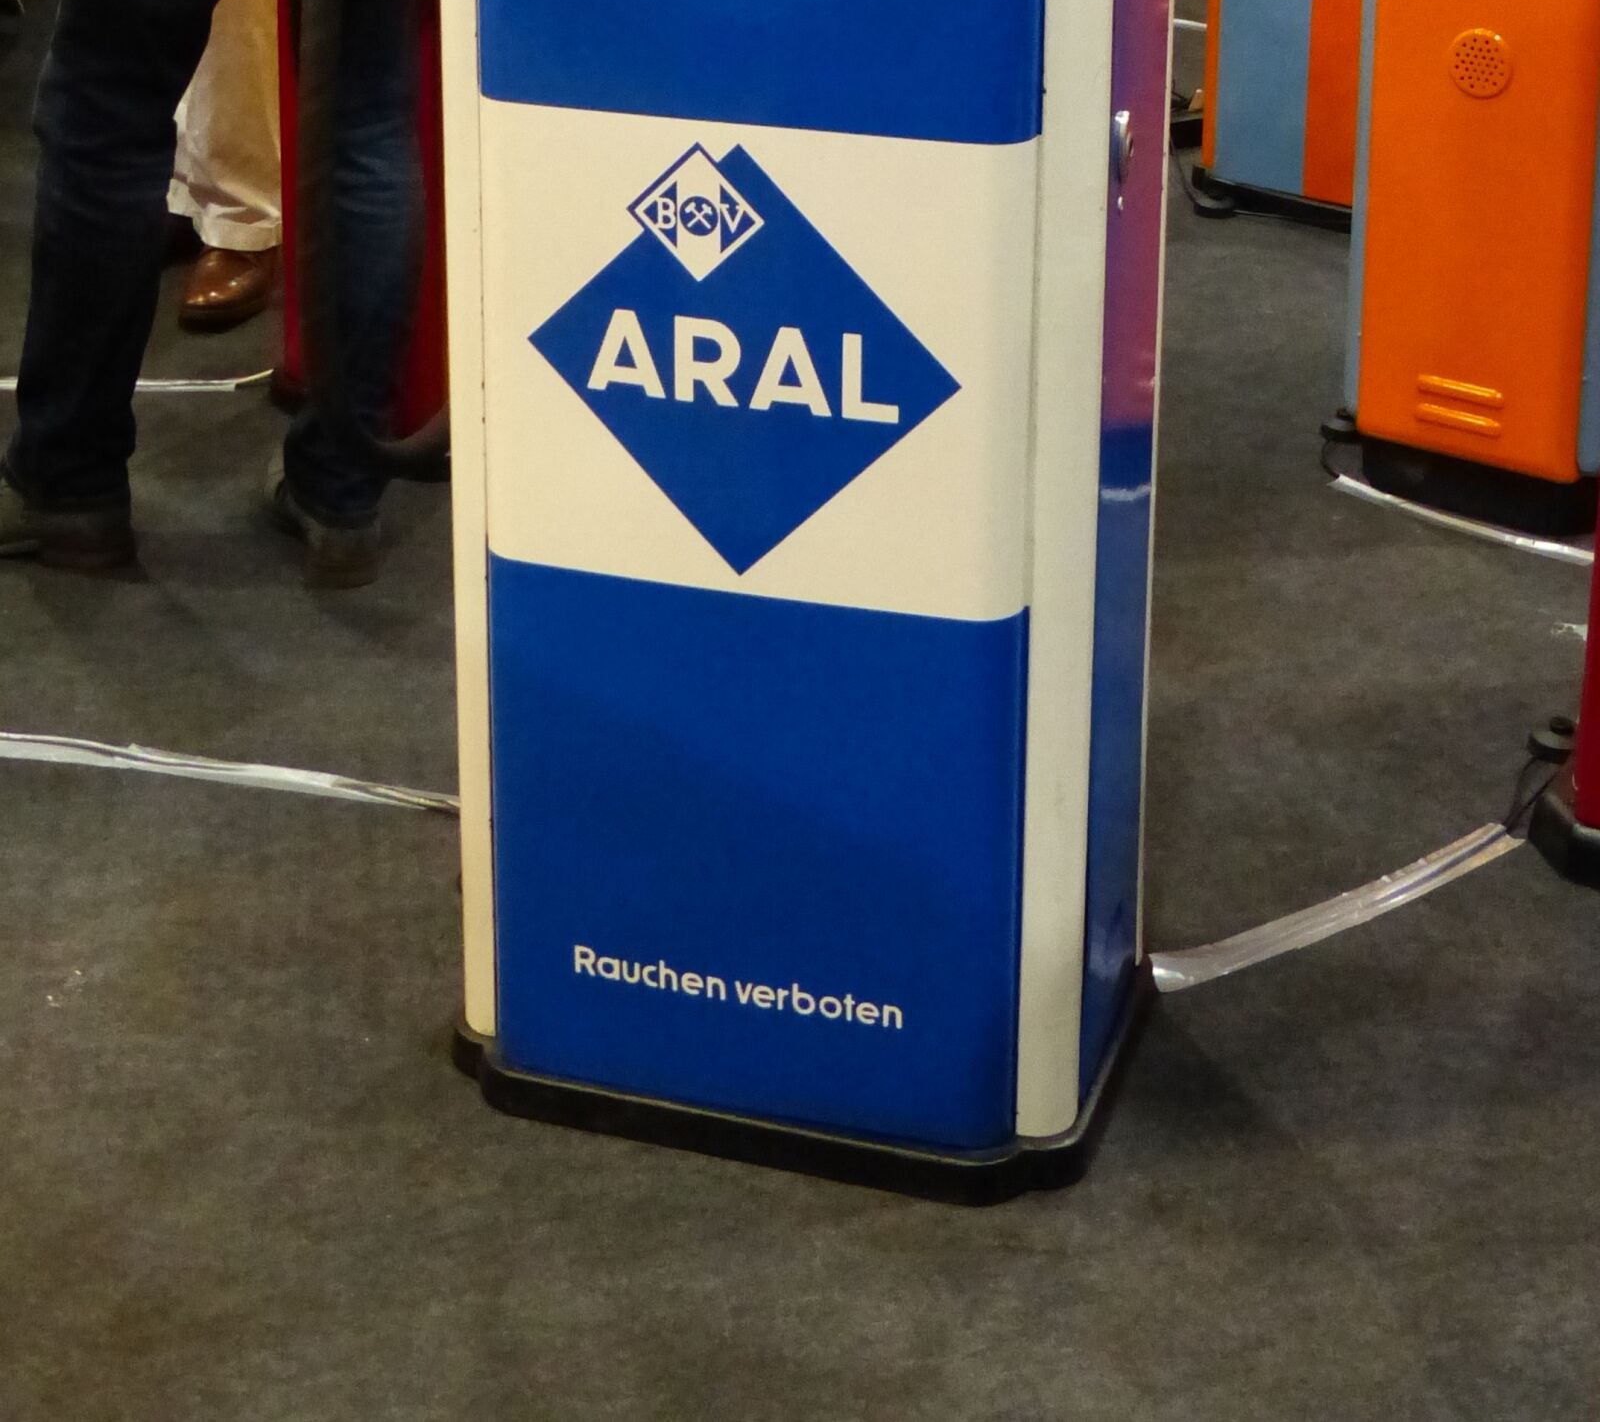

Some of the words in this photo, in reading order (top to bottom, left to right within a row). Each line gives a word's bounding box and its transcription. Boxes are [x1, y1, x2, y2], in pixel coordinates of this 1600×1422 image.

[587, 308, 900, 425] ARAL
[574, 944, 726, 1001] Rauchen
[735, 980, 903, 1030] verboten
